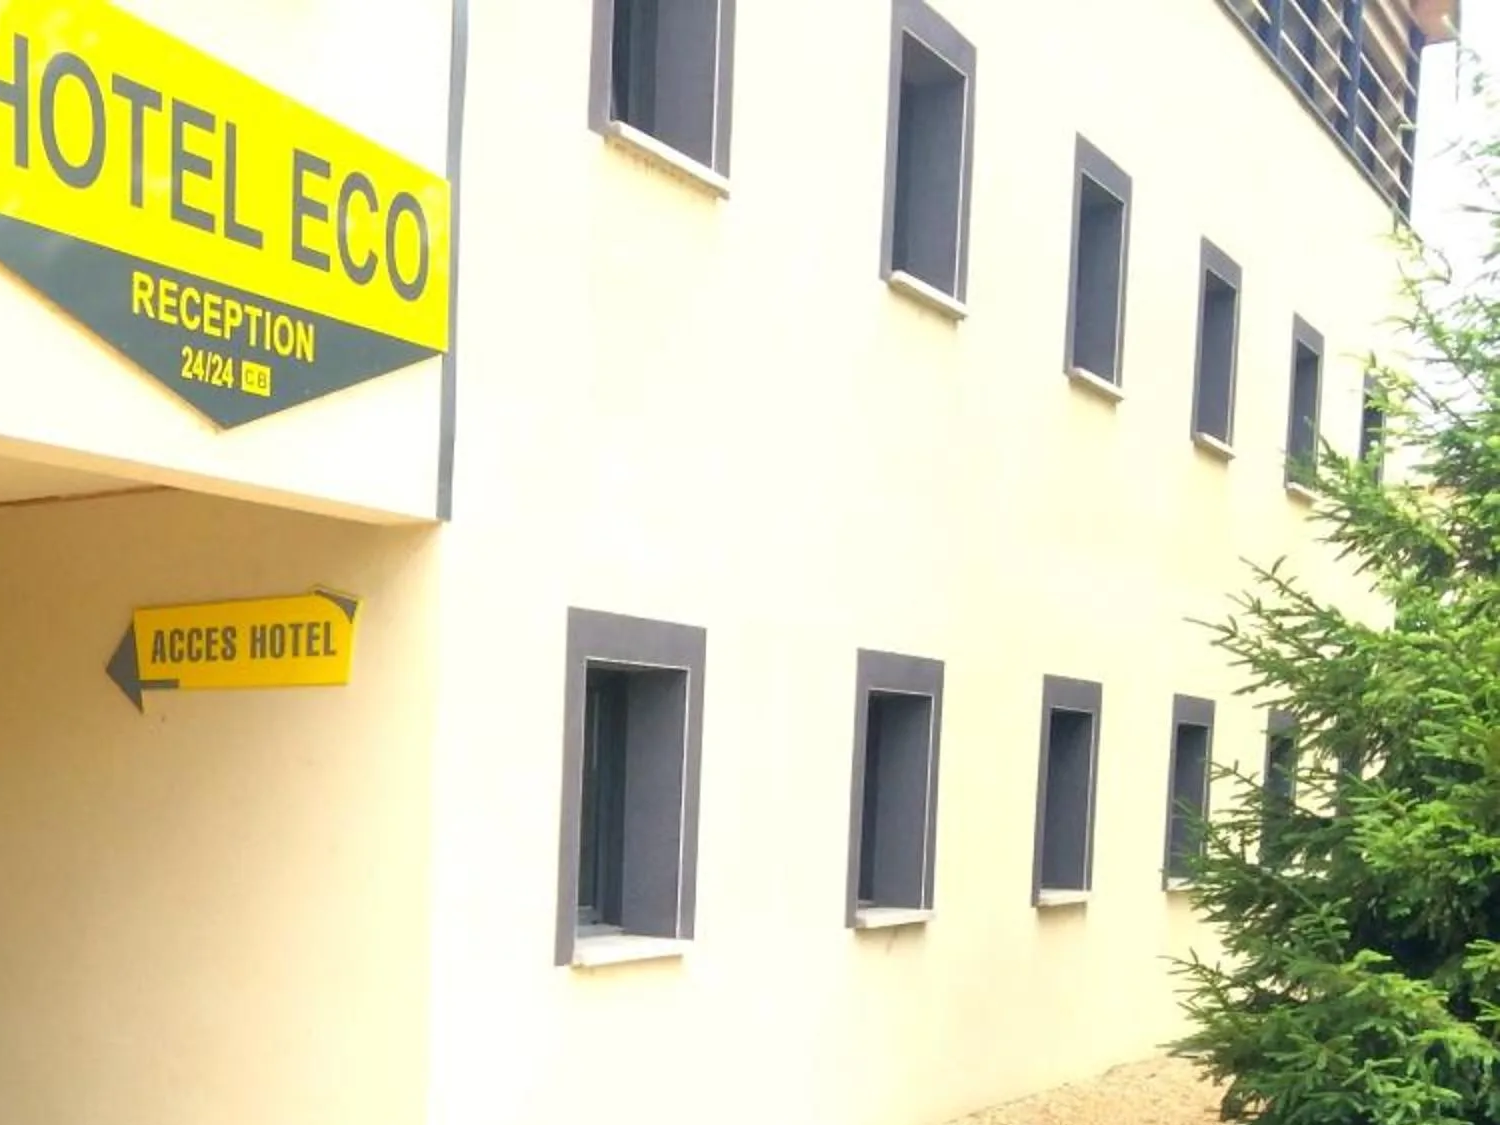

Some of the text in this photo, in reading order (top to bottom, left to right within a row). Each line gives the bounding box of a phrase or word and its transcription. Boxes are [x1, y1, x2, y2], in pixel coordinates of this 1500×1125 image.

[291, 147, 430, 303] ECO
[132, 271, 315, 363] RECEPTION
[181, 345, 268, 390] 24/24 CB
[151, 621, 338, 664] ACCES HOTEL
